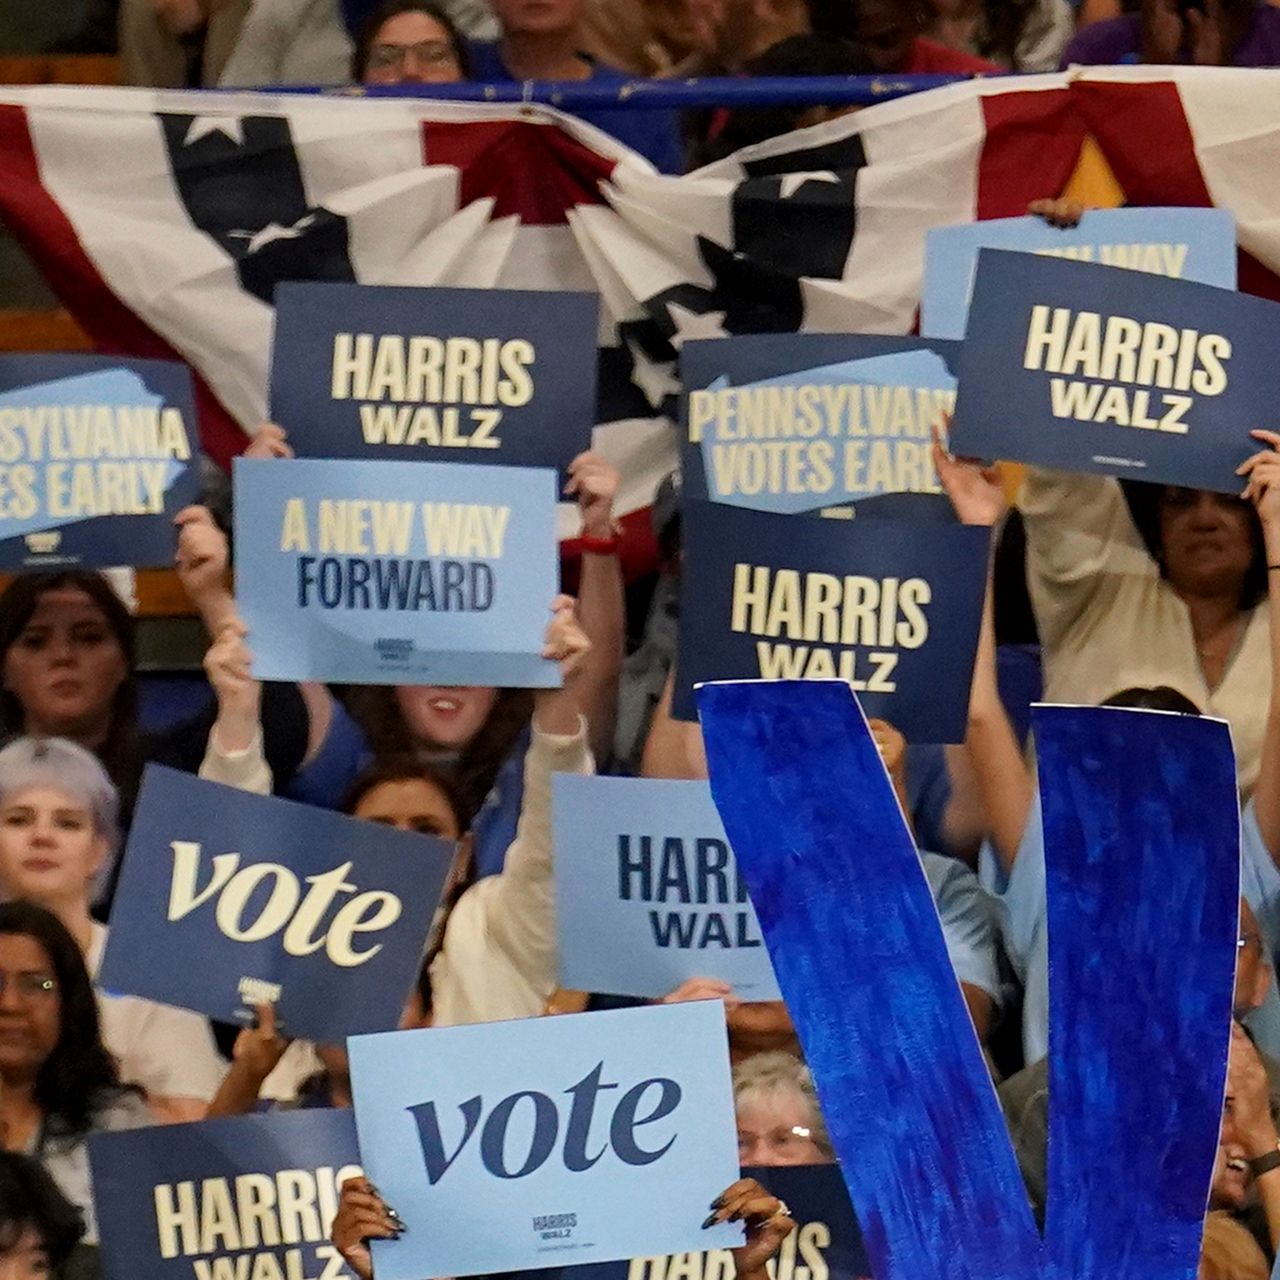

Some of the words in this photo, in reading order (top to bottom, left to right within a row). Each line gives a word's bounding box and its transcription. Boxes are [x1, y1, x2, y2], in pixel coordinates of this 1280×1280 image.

[331, 332, 535, 406] HARRIS
[1023, 305, 1232, 396] HARRIS
[359, 406, 502, 449] WALZ
[1050, 378, 1193, 434] WALZ
[46, 461, 164, 516] EARLY
[713, 441, 834, 496] VOTES
[845, 440, 945, 494] EARL
[281, 498, 309, 552] A
[317, 500, 414, 555] NEW
[424, 502, 511, 558] WAY
[298, 556, 495, 613] FORWARD
[731, 563, 931, 650] HARRIS
[756, 642, 898, 692] WALZ
[168, 840, 402, 968] vote
[650, 910, 760, 949] WAL
[406, 1060, 682, 1187] vote
[533, 1212, 577, 1230] HARRIS
